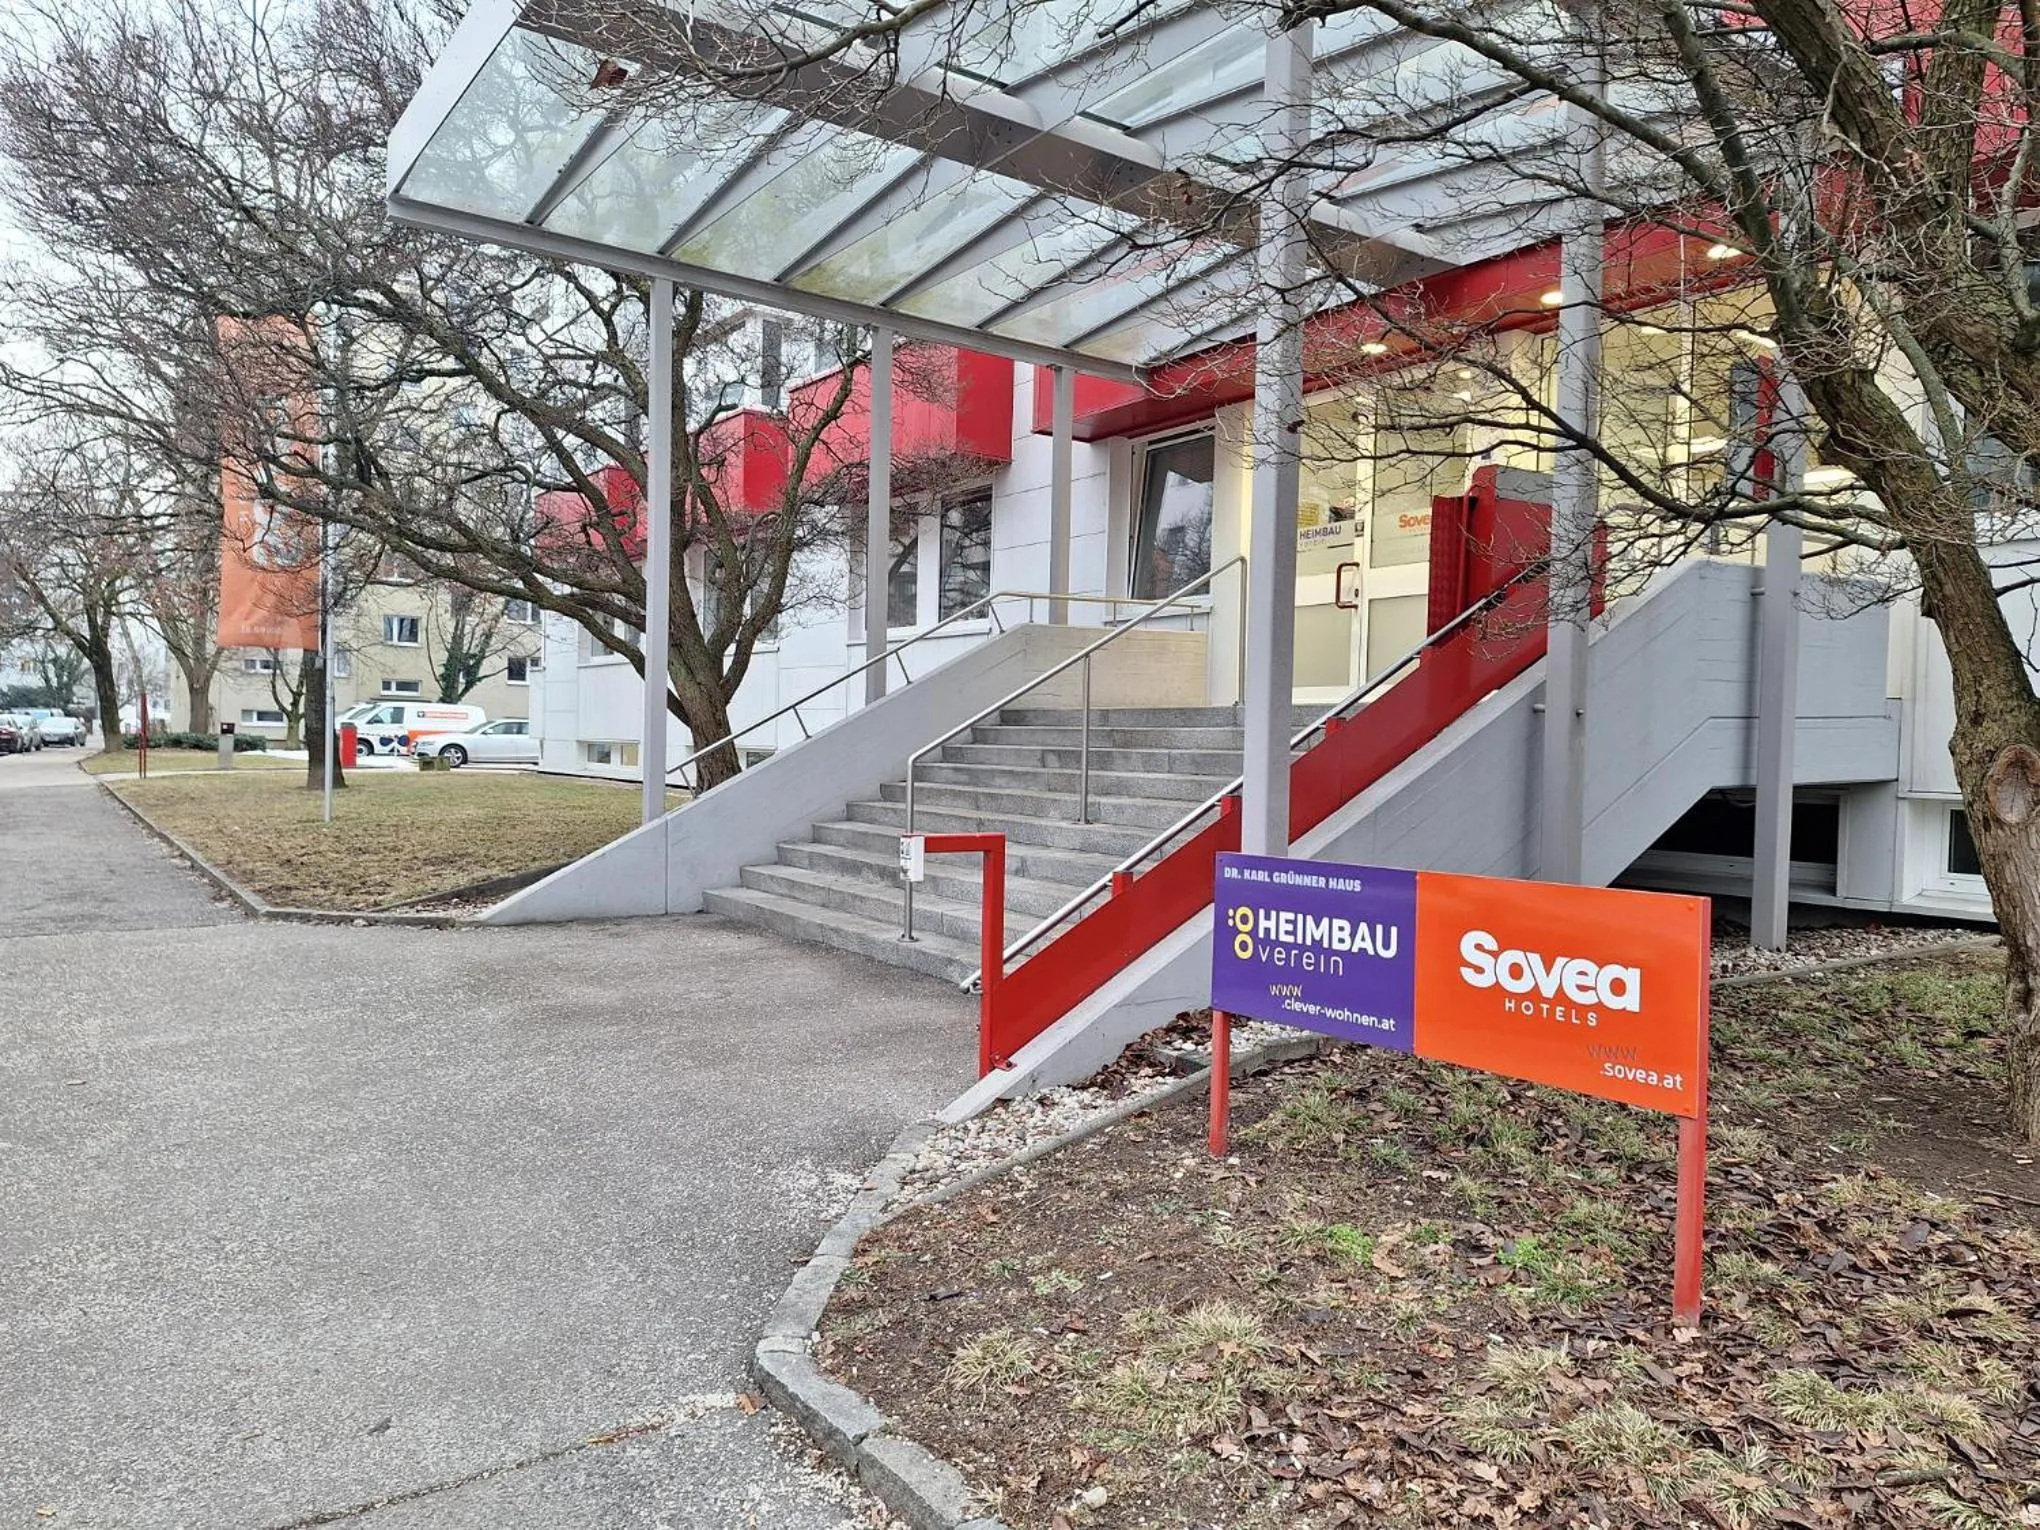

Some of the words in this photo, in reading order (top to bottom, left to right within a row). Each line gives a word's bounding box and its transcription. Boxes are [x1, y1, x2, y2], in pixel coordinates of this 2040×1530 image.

[1299, 524, 1342, 540] HEIMBAU
[1398, 513, 1431, 528] Sove
[1223, 866, 1241, 880] DR.
[1243, 867, 1271, 883] KARL
[1272, 870, 1326, 889] GRÜNNER
[1328, 878, 1362, 892] HAUS
[1258, 908, 1398, 959] HEIMBAU
[1257, 944, 1344, 977] verein
[1459, 929, 1641, 1013] Sovea
[1281, 997, 1397, 1032] .clever-wohnen.at
[1504, 998, 1599, 1027] HOTELS
[1599, 1062, 1684, 1092] .sovea.at
